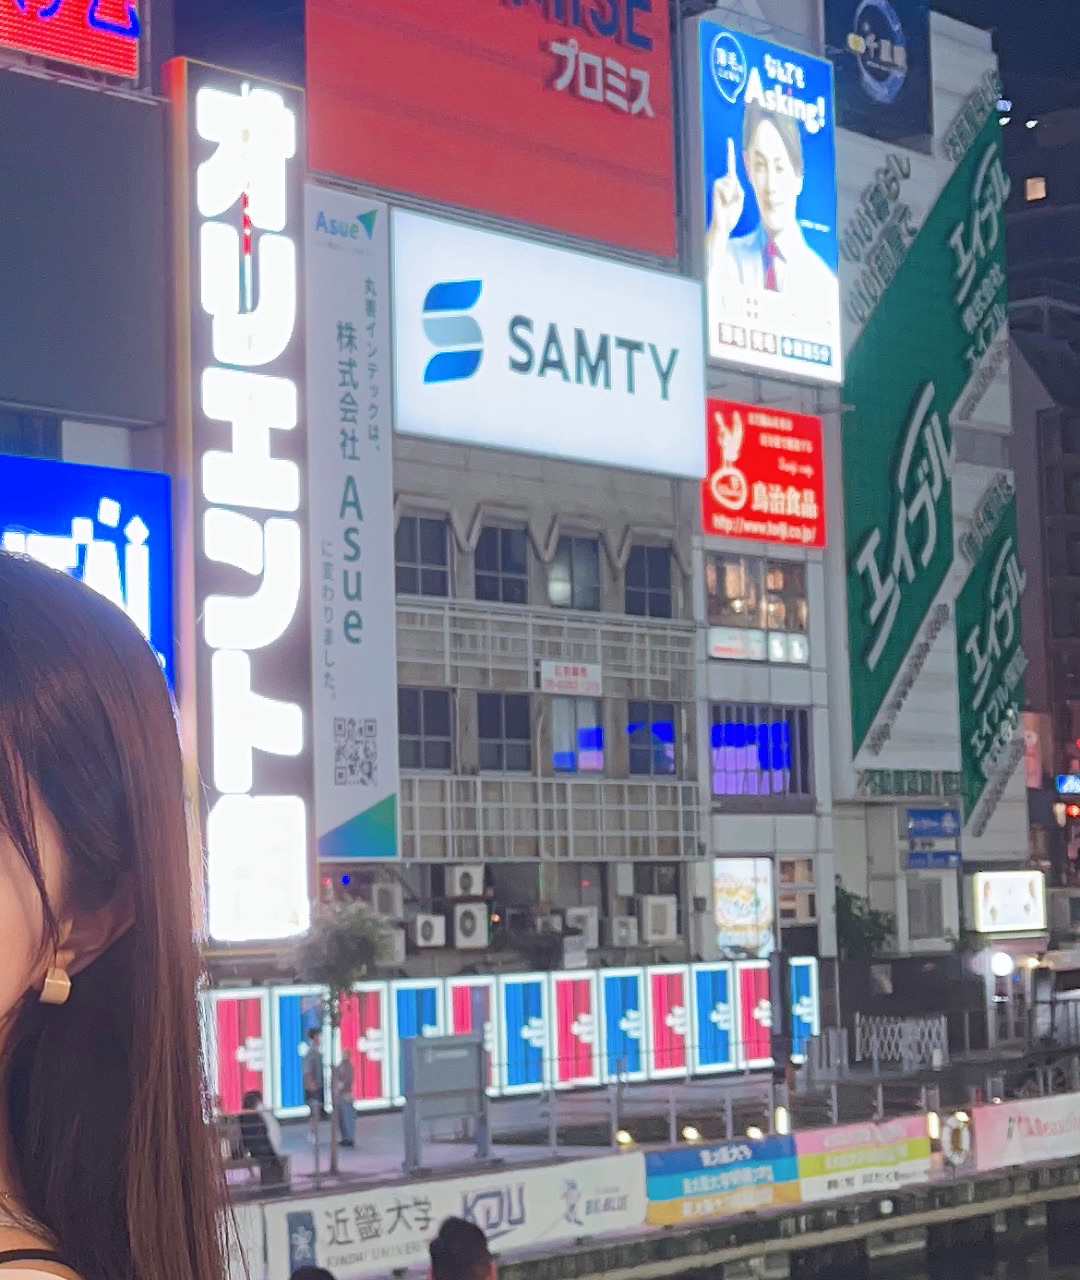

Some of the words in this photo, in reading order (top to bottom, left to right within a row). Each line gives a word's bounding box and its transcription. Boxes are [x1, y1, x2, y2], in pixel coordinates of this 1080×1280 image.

[550, 39, 655, 117] プロミス
[744, 66, 825, 135] Asking!
[315, 210, 359, 240] Asue
[508, 313, 680, 402] SAMTY
[856, 410, 956, 625] エイブル
[324, 1196, 433, 1247] 近畿大学
